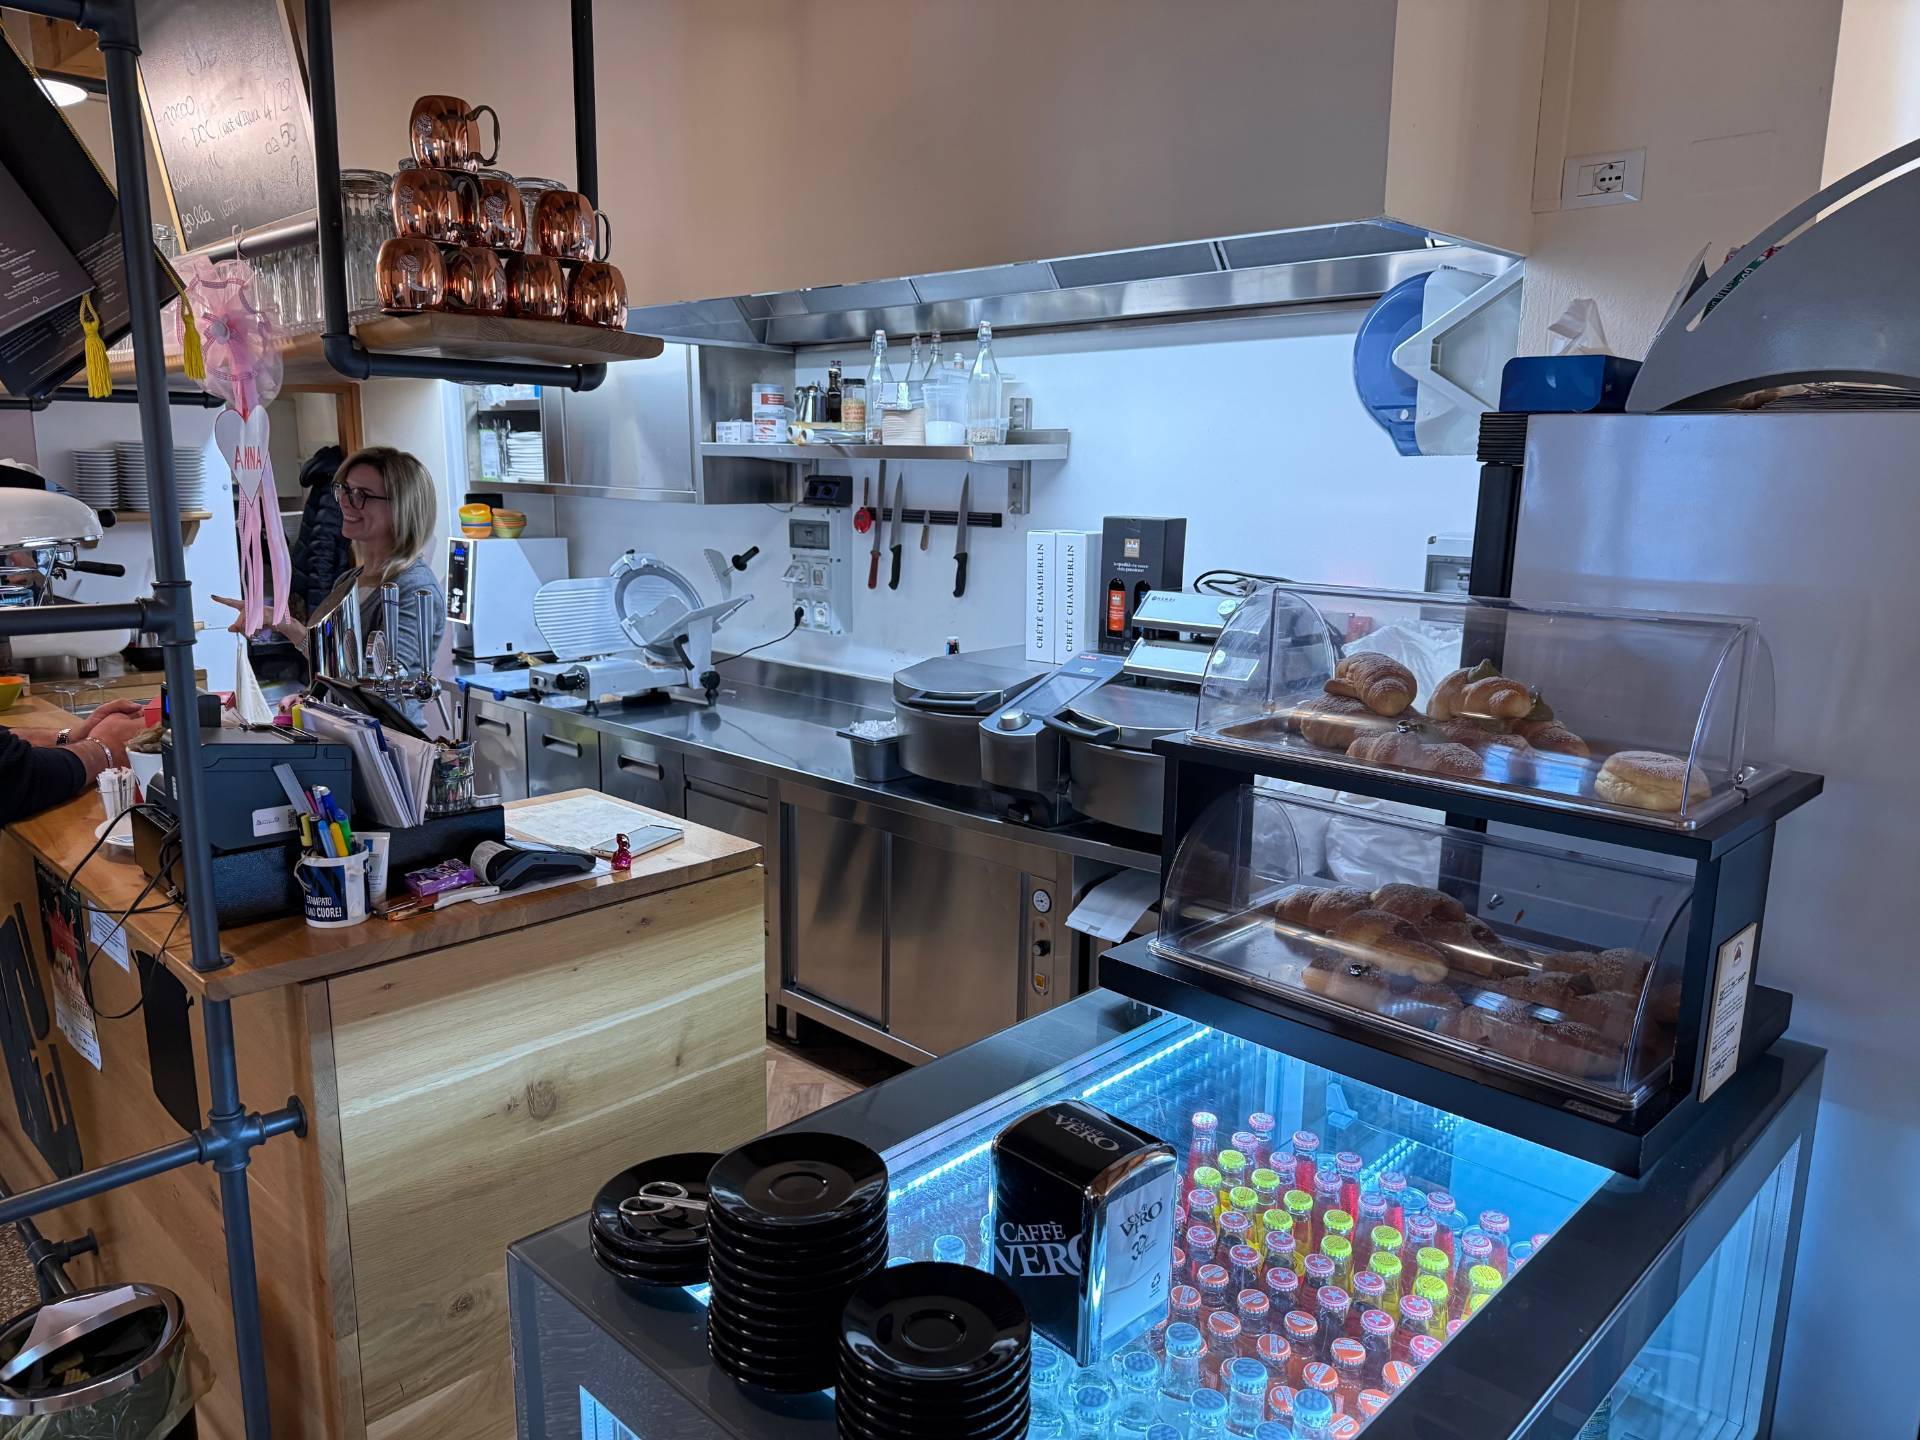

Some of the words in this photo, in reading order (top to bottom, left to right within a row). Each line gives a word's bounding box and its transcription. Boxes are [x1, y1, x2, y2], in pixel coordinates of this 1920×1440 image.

[234, 445, 262, 470] ANNA
[1035, 543, 1044, 613] CHAMBERLIN
[1066, 544, 1074, 616] CHAMBERLIN
[316, 906, 342, 918] CUORE!
[1055, 1112, 1120, 1151] VERO
[1000, 1220, 1067, 1243] CAFFÈ
